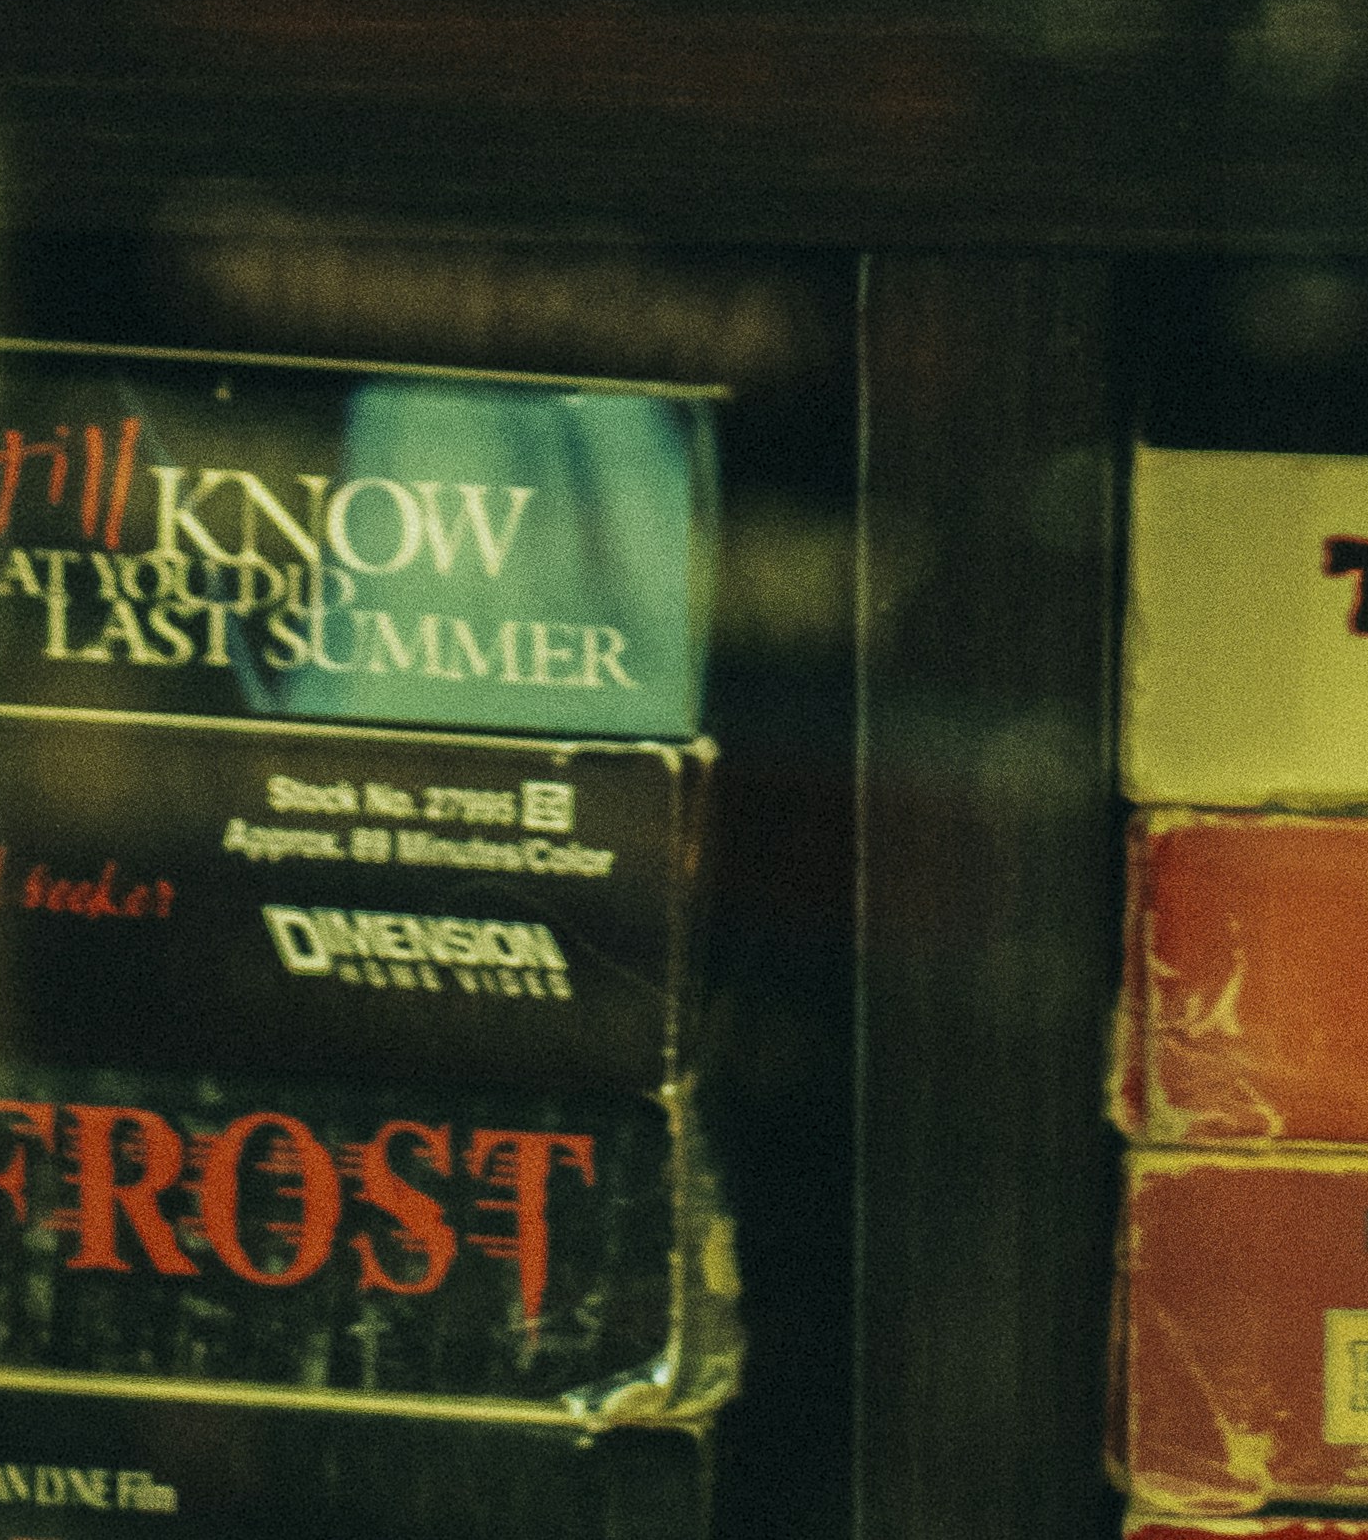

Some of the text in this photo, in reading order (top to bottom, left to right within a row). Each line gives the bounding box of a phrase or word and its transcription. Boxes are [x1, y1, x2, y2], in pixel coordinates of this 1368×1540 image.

[150, 464, 537, 578] KNOW
[93, 547, 233, 609] YOU
[41, 588, 641, 691] LAST SUMMER
[265, 774, 360, 815] Stock
[262, 904, 569, 977] DIMENSION
[116, 1470, 179, 1514] Film
